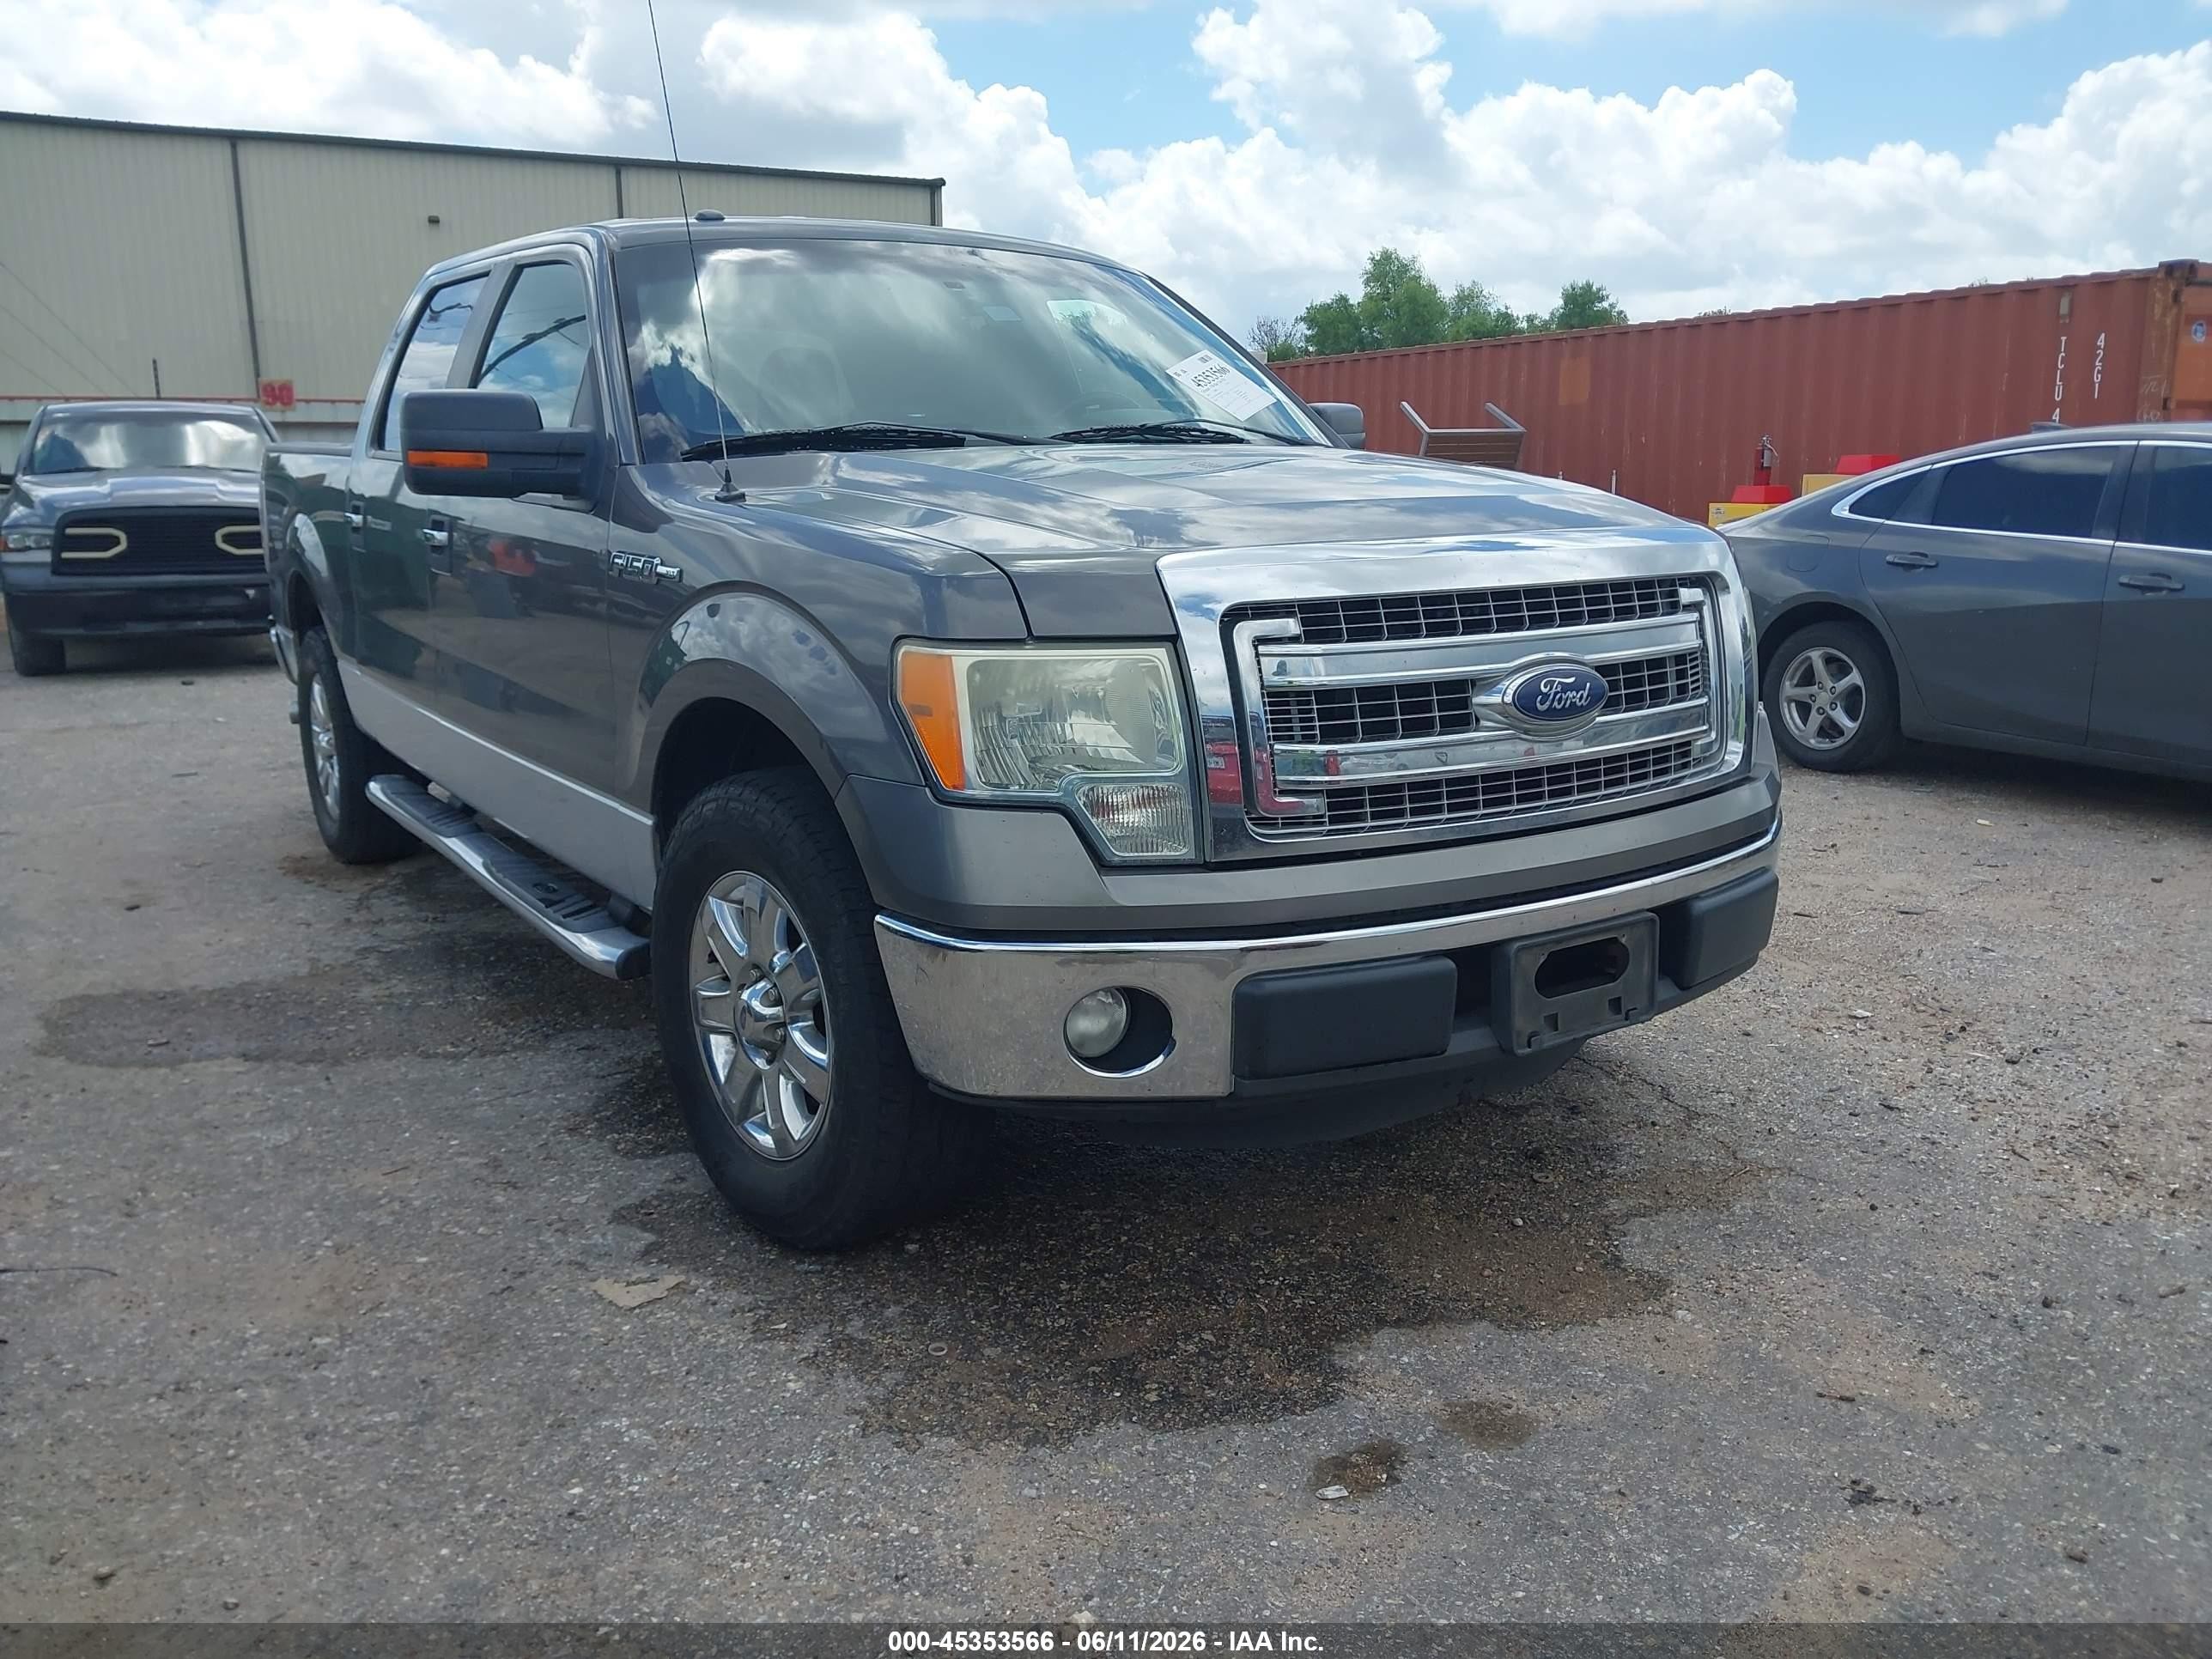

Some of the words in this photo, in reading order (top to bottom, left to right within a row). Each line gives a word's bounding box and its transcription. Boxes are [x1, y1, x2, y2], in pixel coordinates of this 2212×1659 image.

[1190, 363, 1231, 388] 45353566
[2054, 336, 2068, 401] TCLU
[2051, 407, 2061, 424] 4
[1535, 677, 1591, 712] Ford
